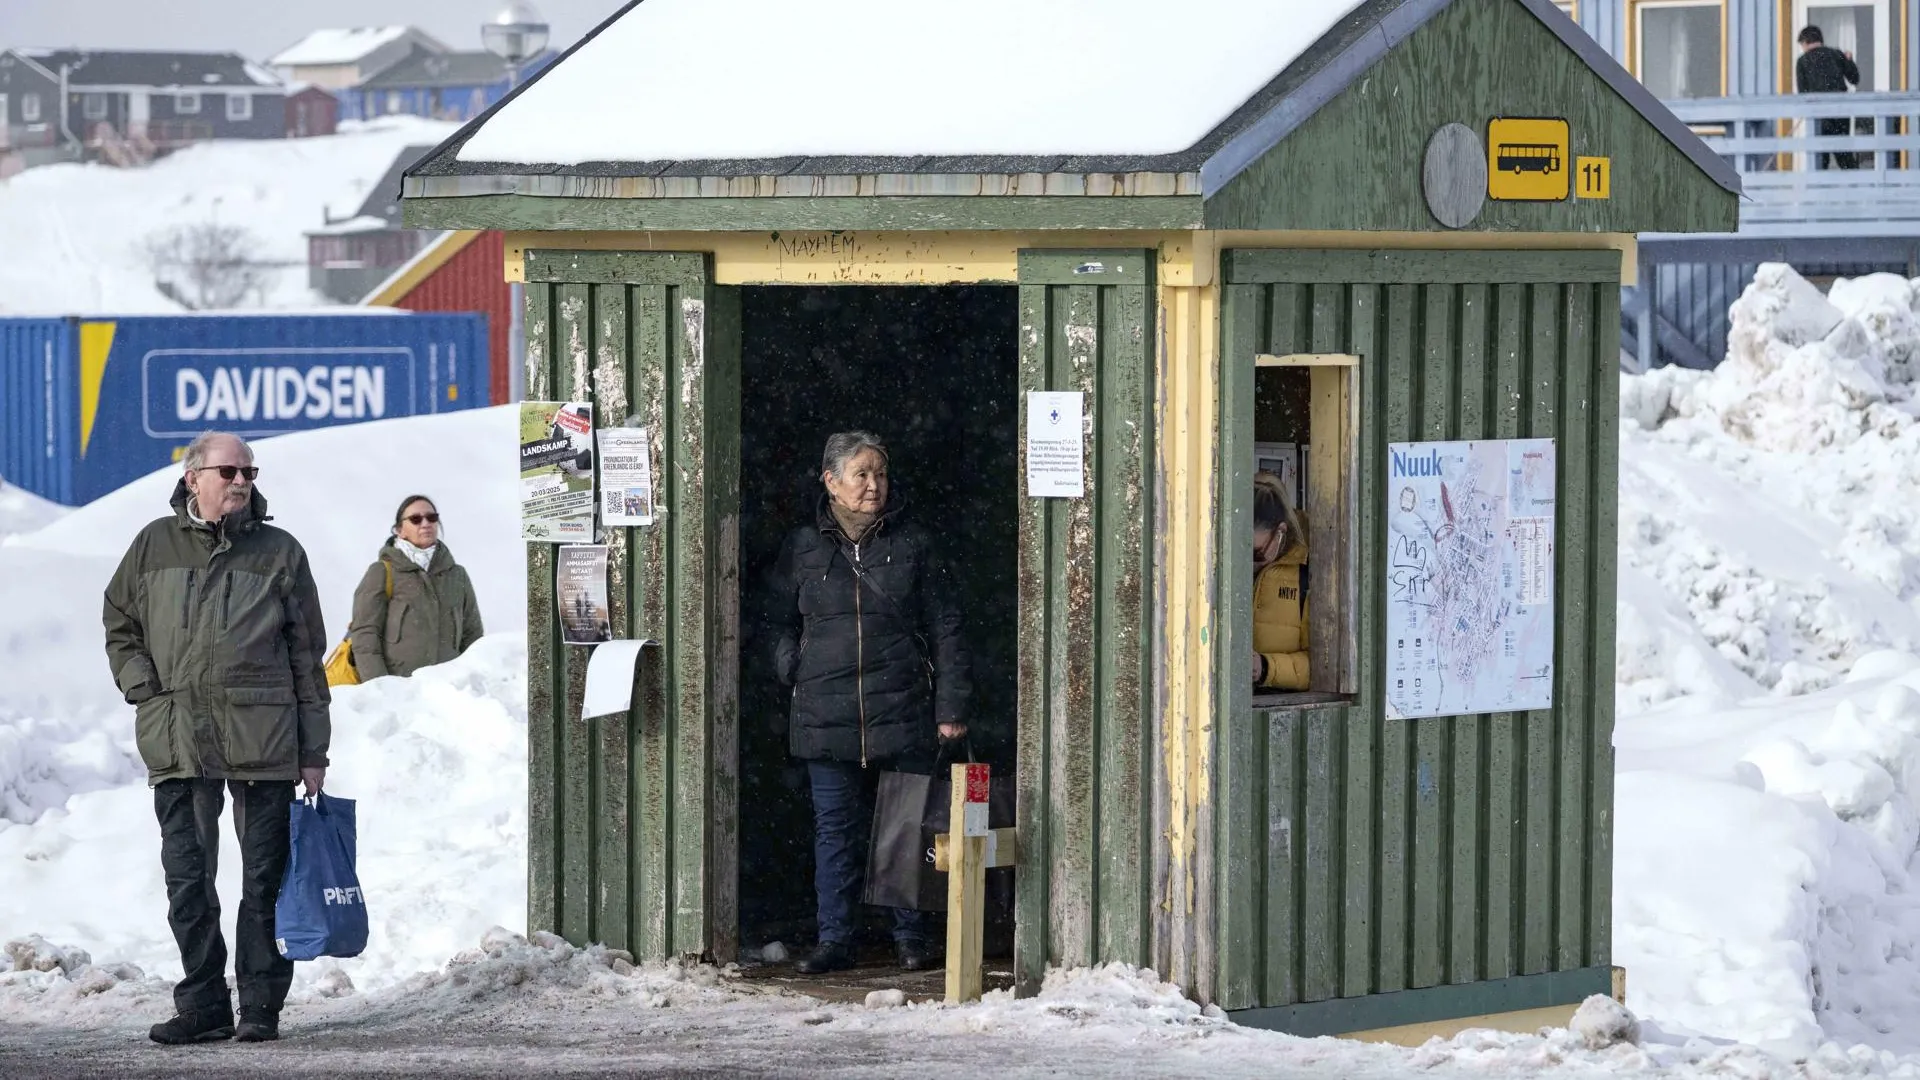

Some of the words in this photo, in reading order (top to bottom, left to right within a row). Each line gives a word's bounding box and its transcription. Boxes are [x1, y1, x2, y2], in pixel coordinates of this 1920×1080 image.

[1582, 163, 1601, 192] 11
[780, 234, 855, 258] MAYHEM
[175, 366, 385, 421] DAVIDSEN
[522, 440, 568, 457] LANDSKAMP
[603, 463, 629, 471] GREENLANDIC
[1393, 448, 1443, 478] Nuuk
[925, 847, 936, 863] S
